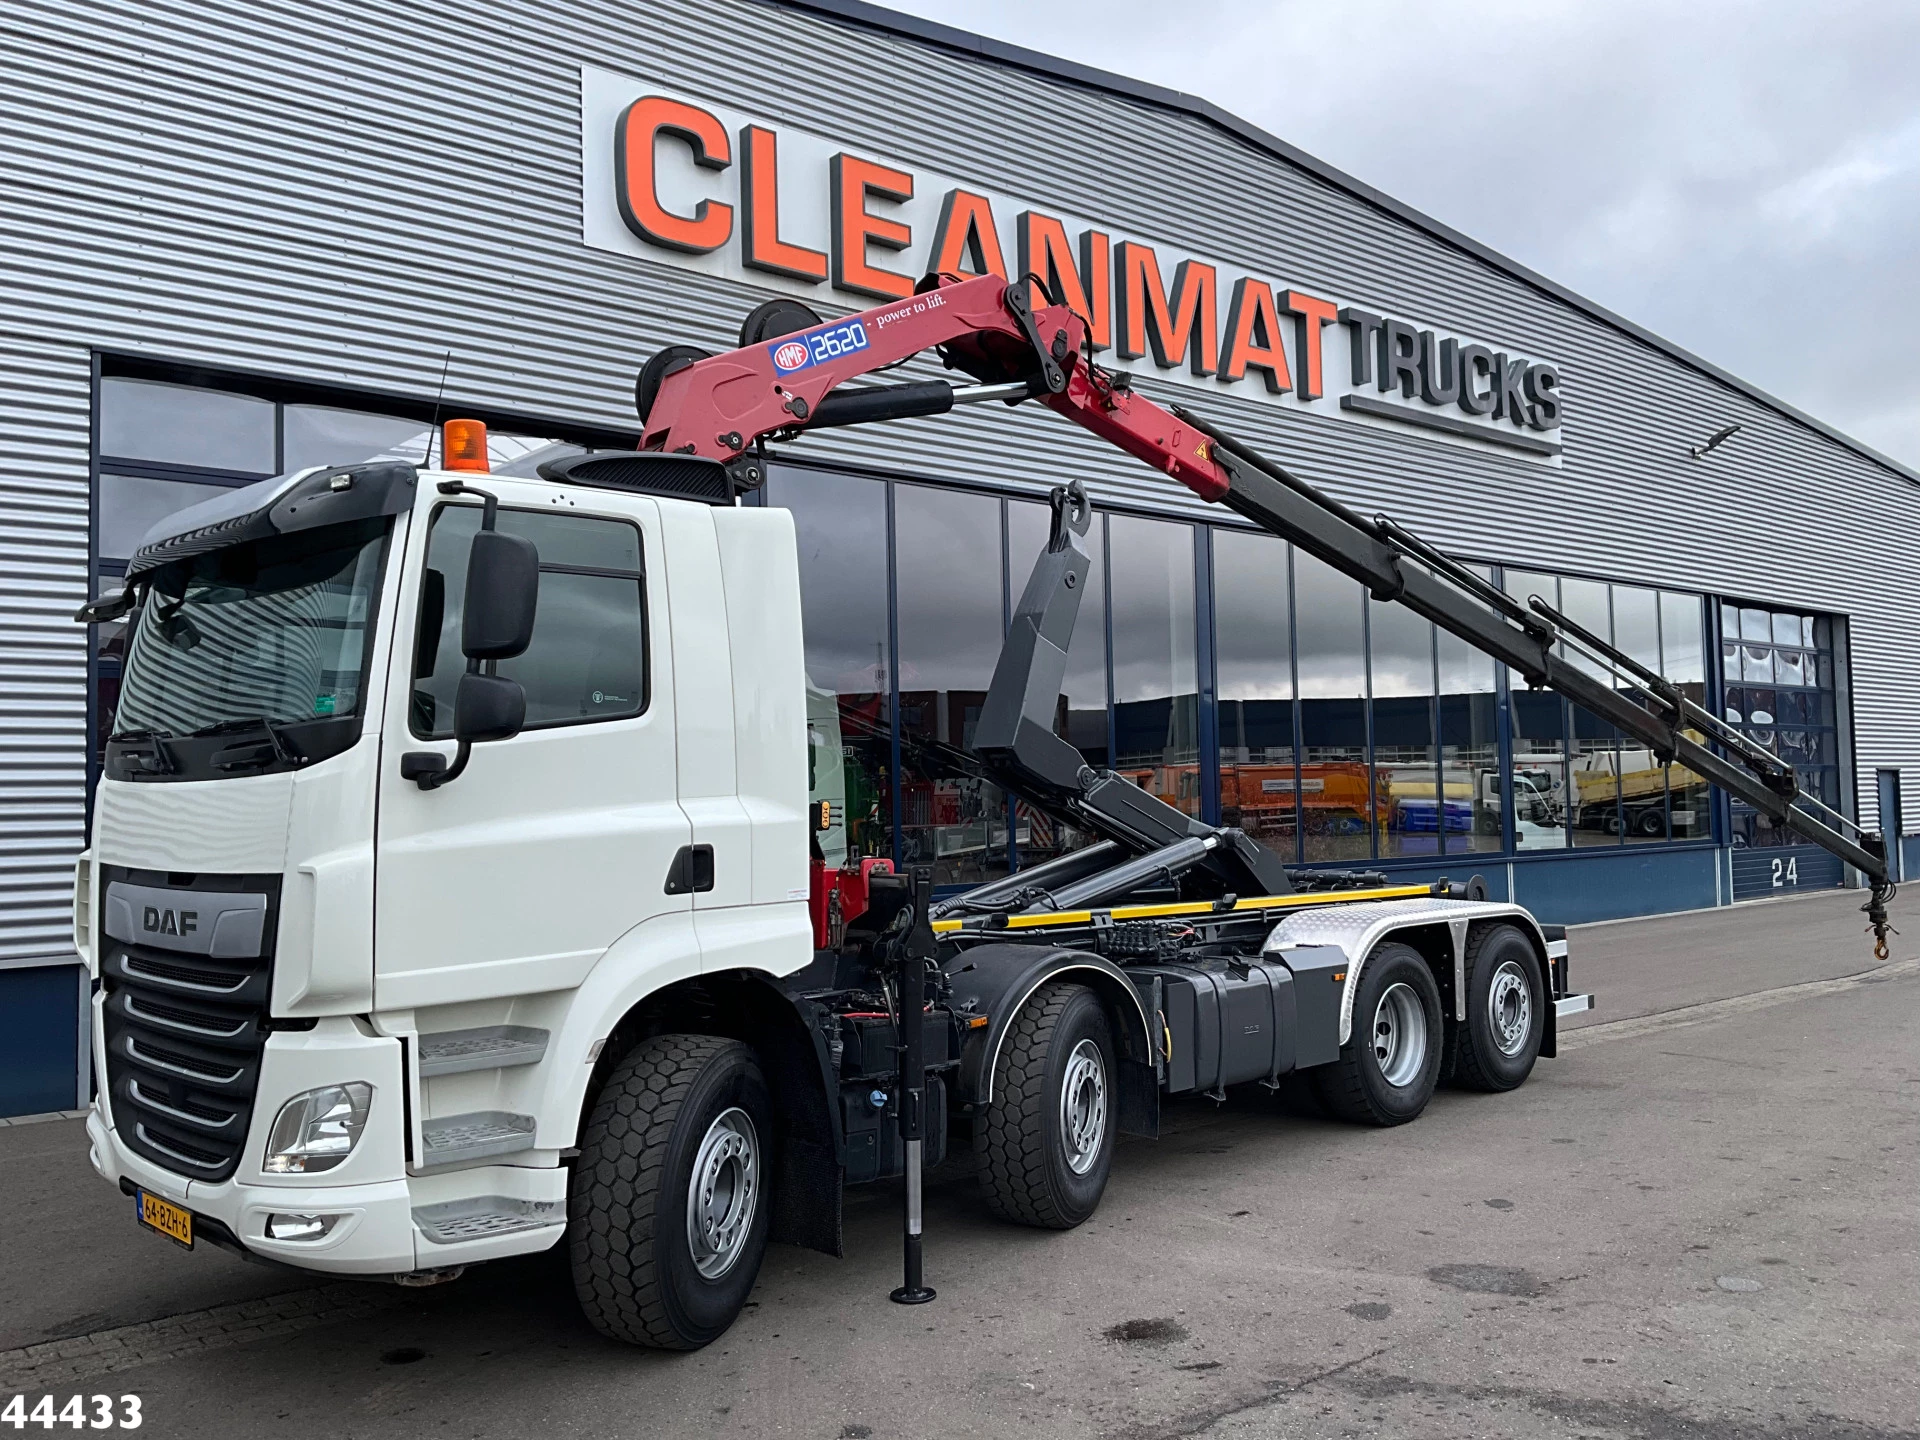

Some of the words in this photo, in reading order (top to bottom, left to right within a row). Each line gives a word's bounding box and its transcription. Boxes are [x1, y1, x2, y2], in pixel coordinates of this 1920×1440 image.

[614, 95, 1338, 400] CLEANMAT
[1339, 307, 1562, 430] TRUCKS
[778, 346, 803, 367] HMF
[811, 323, 868, 361] 2620
[876, 307, 911, 329] power
[913, 302, 926, 314] to
[927, 293, 947, 309] lift.
[1771, 857, 1798, 888] 24
[143, 906, 198, 937] DAF
[145, 1198, 188, 1238] 64-BZH-6
